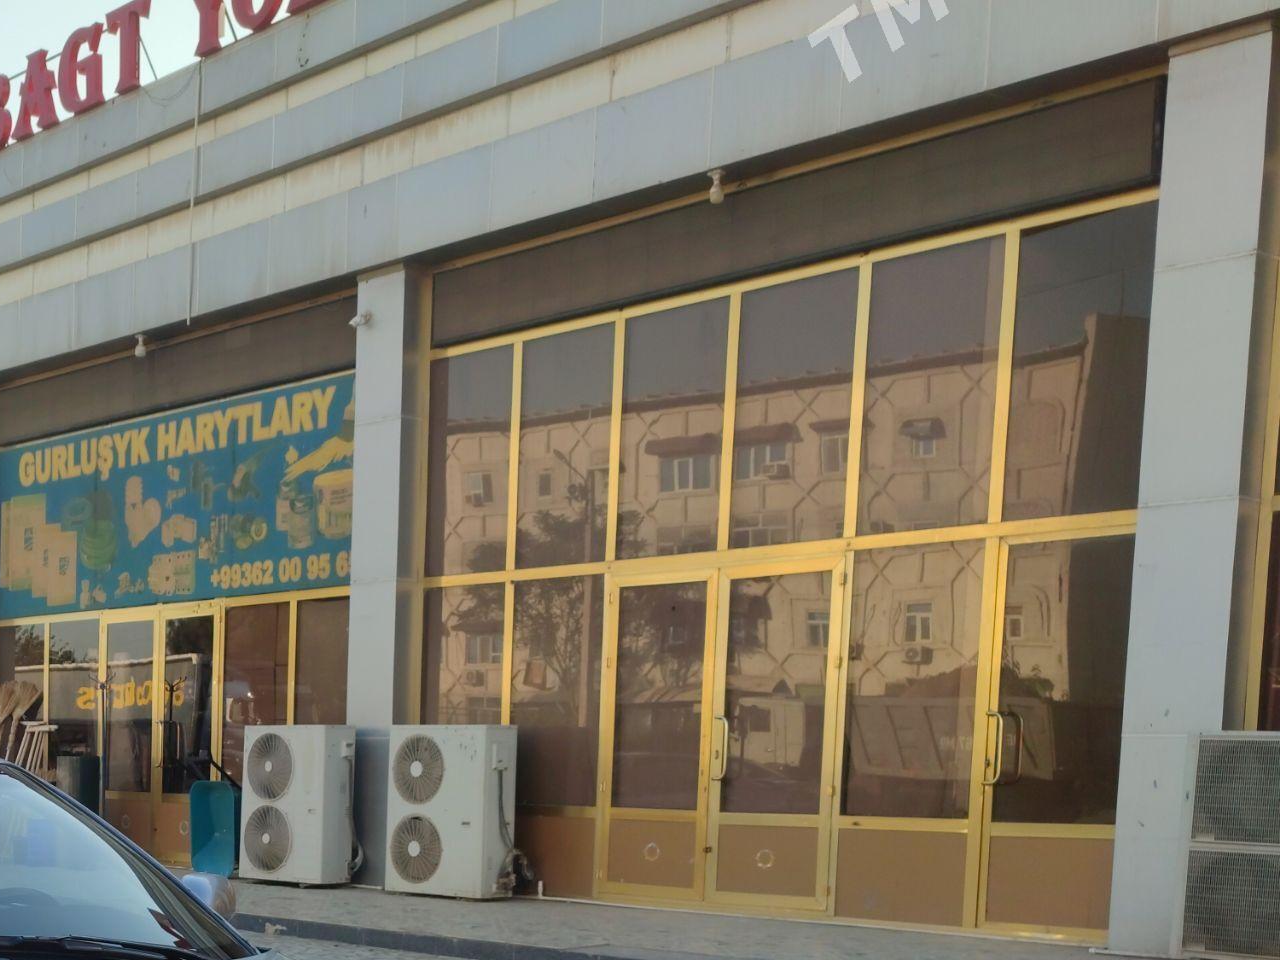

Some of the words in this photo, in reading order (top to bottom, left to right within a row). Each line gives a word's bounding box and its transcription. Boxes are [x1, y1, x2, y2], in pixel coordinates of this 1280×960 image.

[19, 426, 150, 486] GURLUŞYK
[157, 386, 336, 460] HARYTLARY
[278, 556, 302, 583] 00
